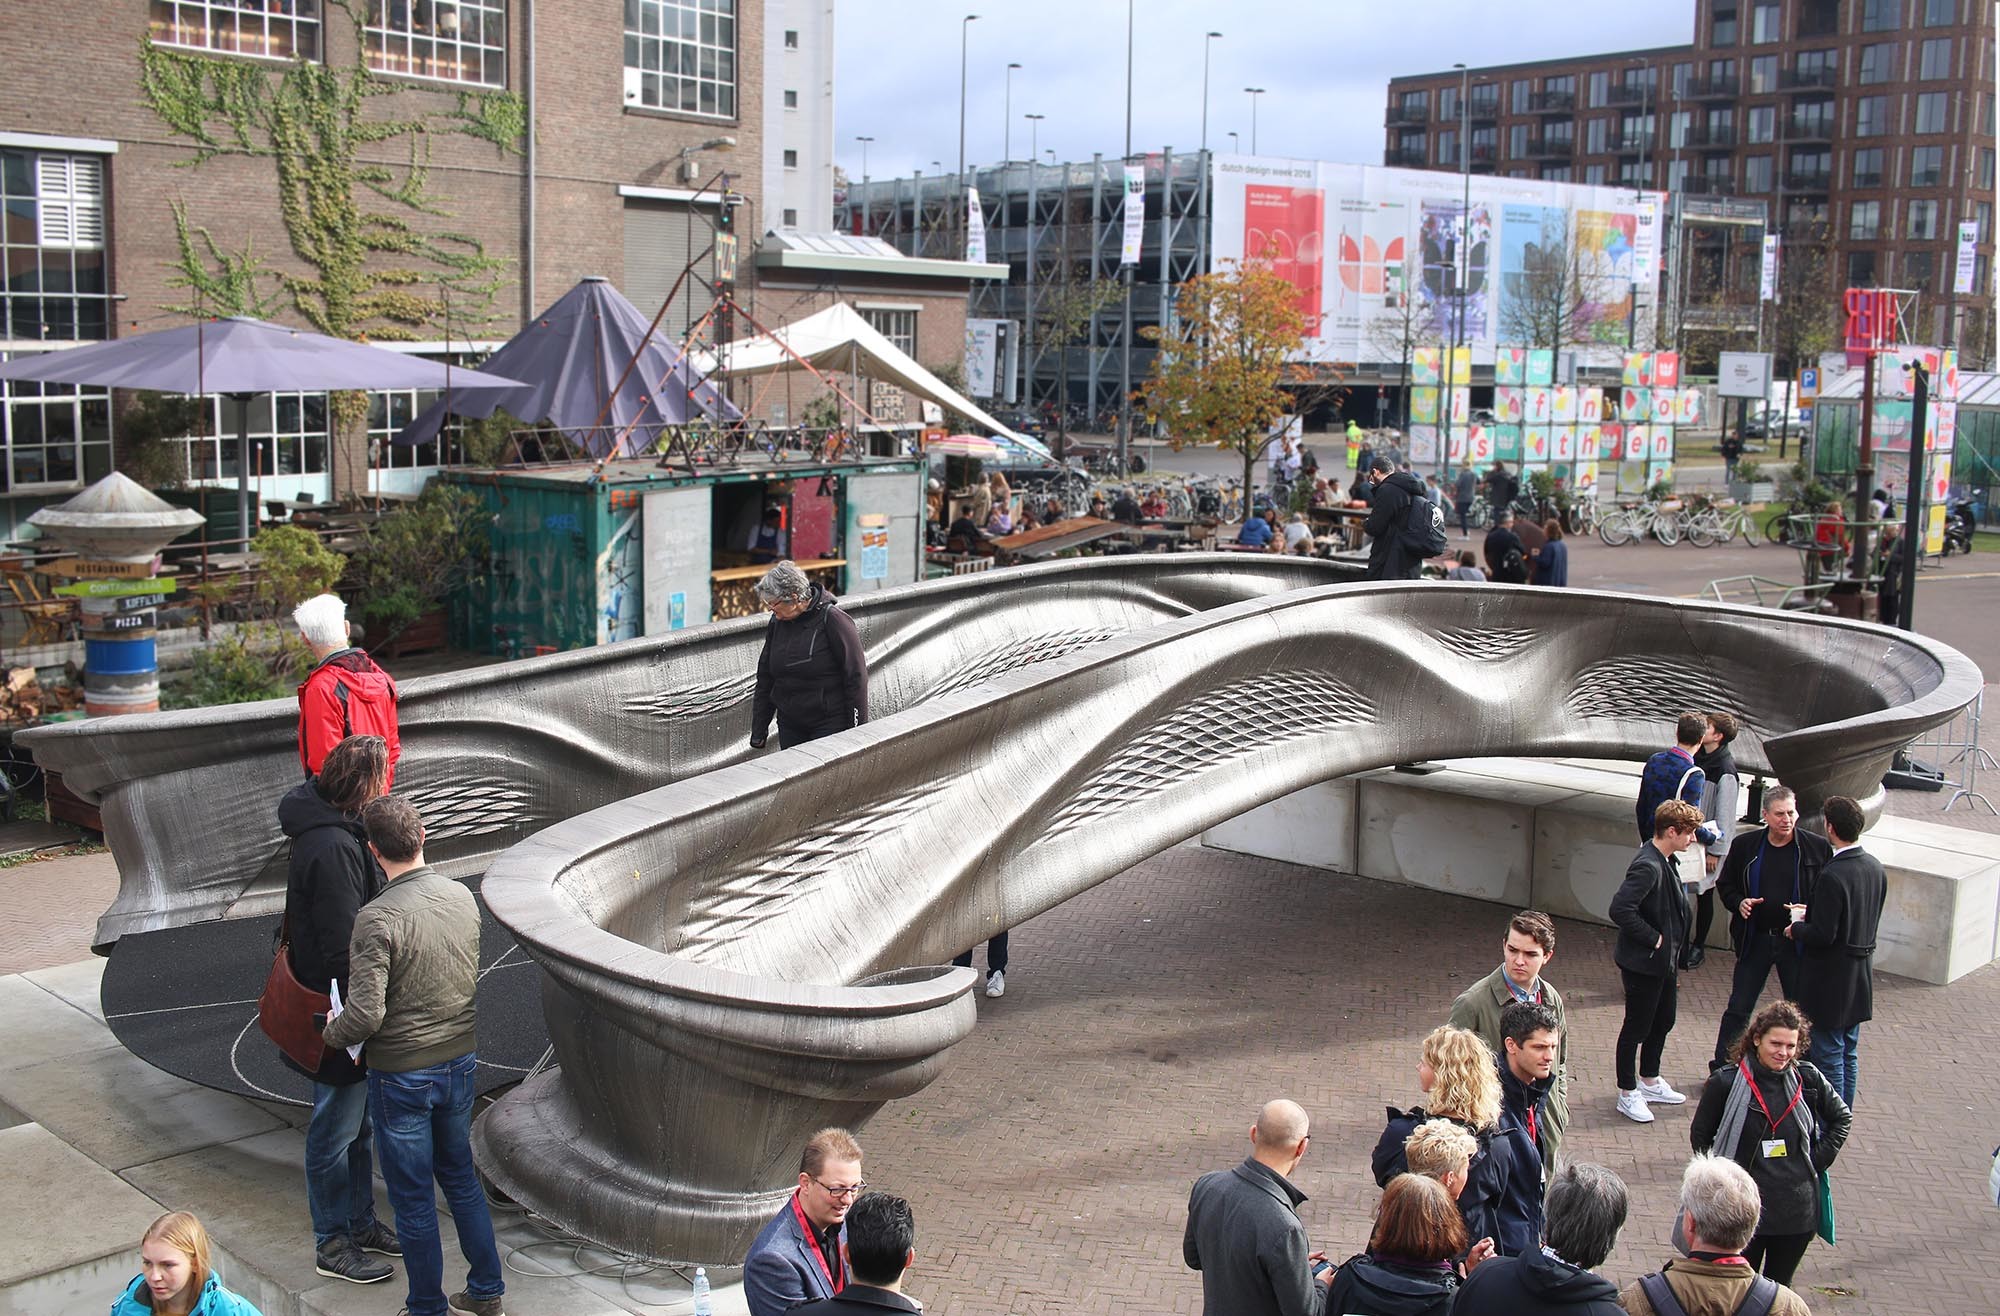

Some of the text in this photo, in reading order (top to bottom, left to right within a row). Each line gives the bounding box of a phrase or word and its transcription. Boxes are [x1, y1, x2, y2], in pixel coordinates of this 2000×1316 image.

[1804, 371, 1814, 386] P
[75, 564, 131, 574] RESTAURANT
[115, 616, 142, 629] PIZZA
